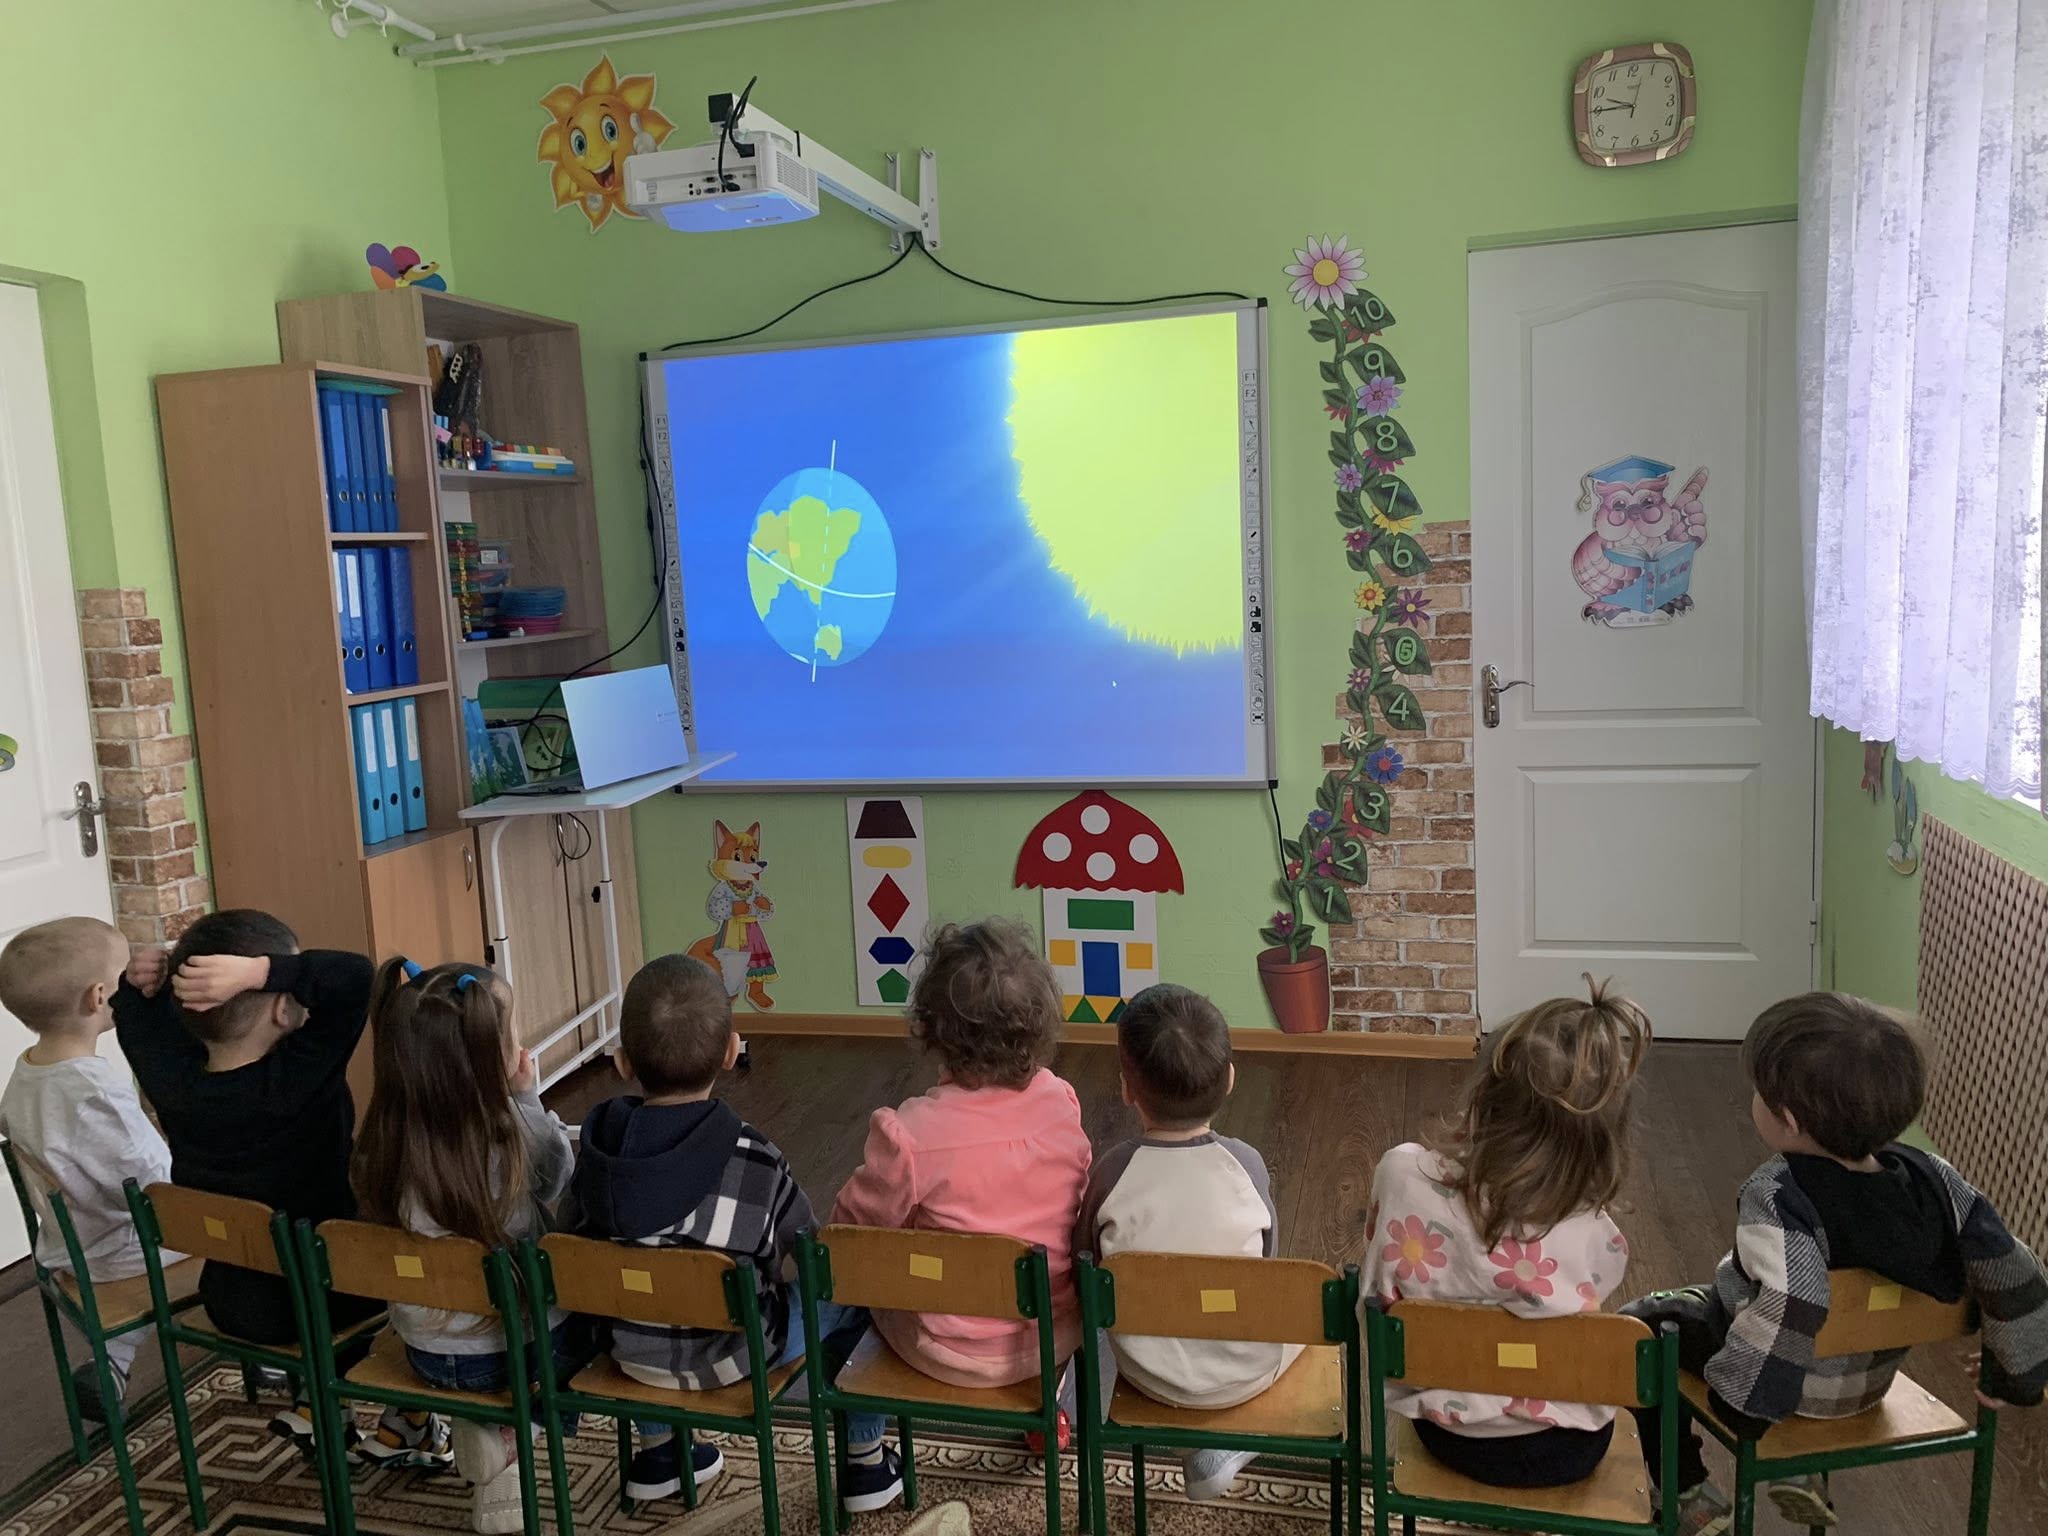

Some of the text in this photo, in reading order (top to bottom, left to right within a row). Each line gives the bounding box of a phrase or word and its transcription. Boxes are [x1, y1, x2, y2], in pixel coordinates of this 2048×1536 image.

[1627, 63, 1639, 78] 12
[1650, 63, 1656, 76] 1
[1608, 71, 1617, 82] 11
[1664, 75, 1672, 88] 2
[1593, 86, 1604, 98] 10
[1666, 94, 1674, 107] 3
[1665, 114, 1673, 127] 4
[1595, 124, 1605, 138] 8
[1650, 130, 1659, 142] 5
[1611, 136, 1619, 148] 7
[1631, 135, 1639, 147] 6
[1350, 296, 1384, 328] 10
[1364, 350, 1387, 377] 9
[1245, 372, 1255, 381] F1
[1245, 389, 1256, 398] F2
[1376, 421, 1399, 452] 8
[1381, 481, 1400, 513] 7
[1392, 538, 1414, 569] 6
[1389, 692, 1410, 721] 4
[1360, 792, 1385, 819] 3
[1335, 841, 1361, 870] 2
[1323, 886, 1335, 914] 1
